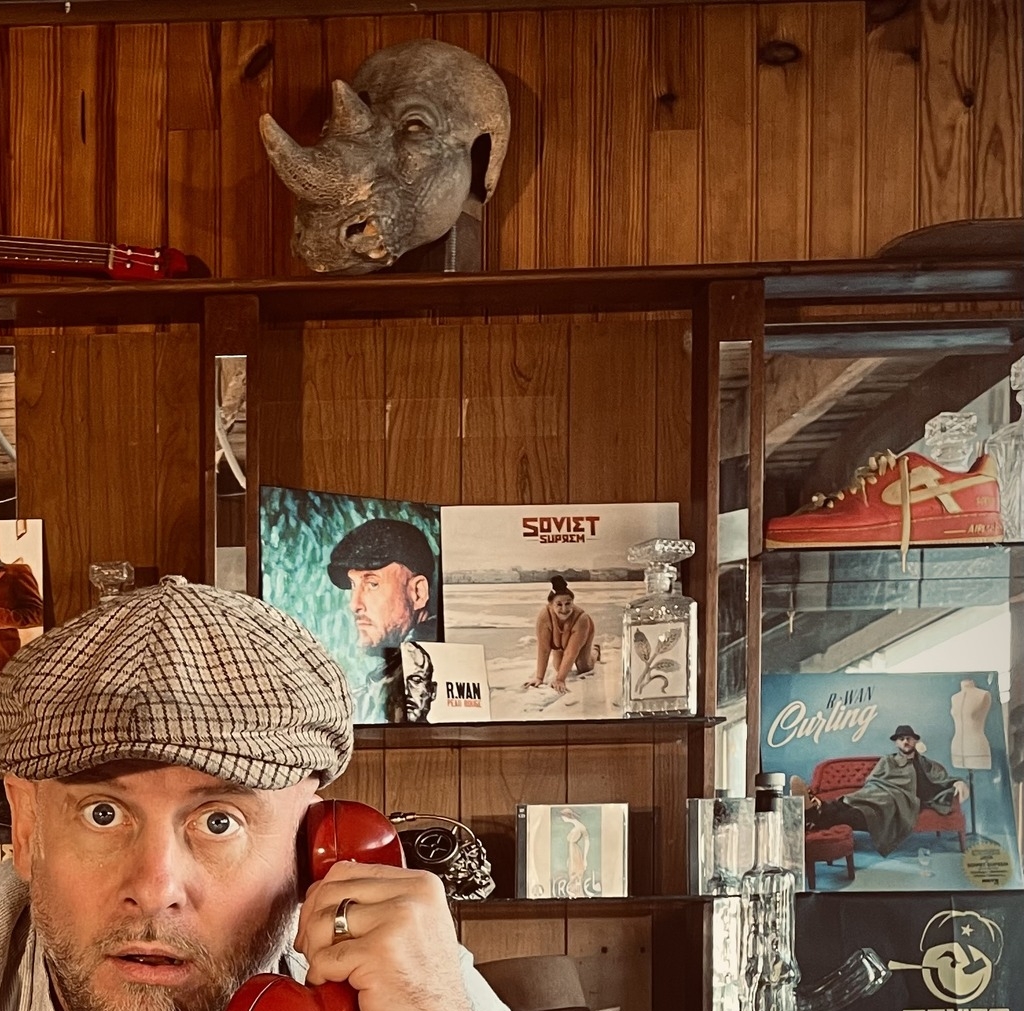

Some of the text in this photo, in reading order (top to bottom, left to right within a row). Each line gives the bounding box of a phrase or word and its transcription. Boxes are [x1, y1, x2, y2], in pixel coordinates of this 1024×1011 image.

[522, 516, 600, 537] SOVIET
[539, 534, 585, 544] SUPREM
[446, 681, 481, 700] R.WAN
[767, 700, 878, 748] Curling
